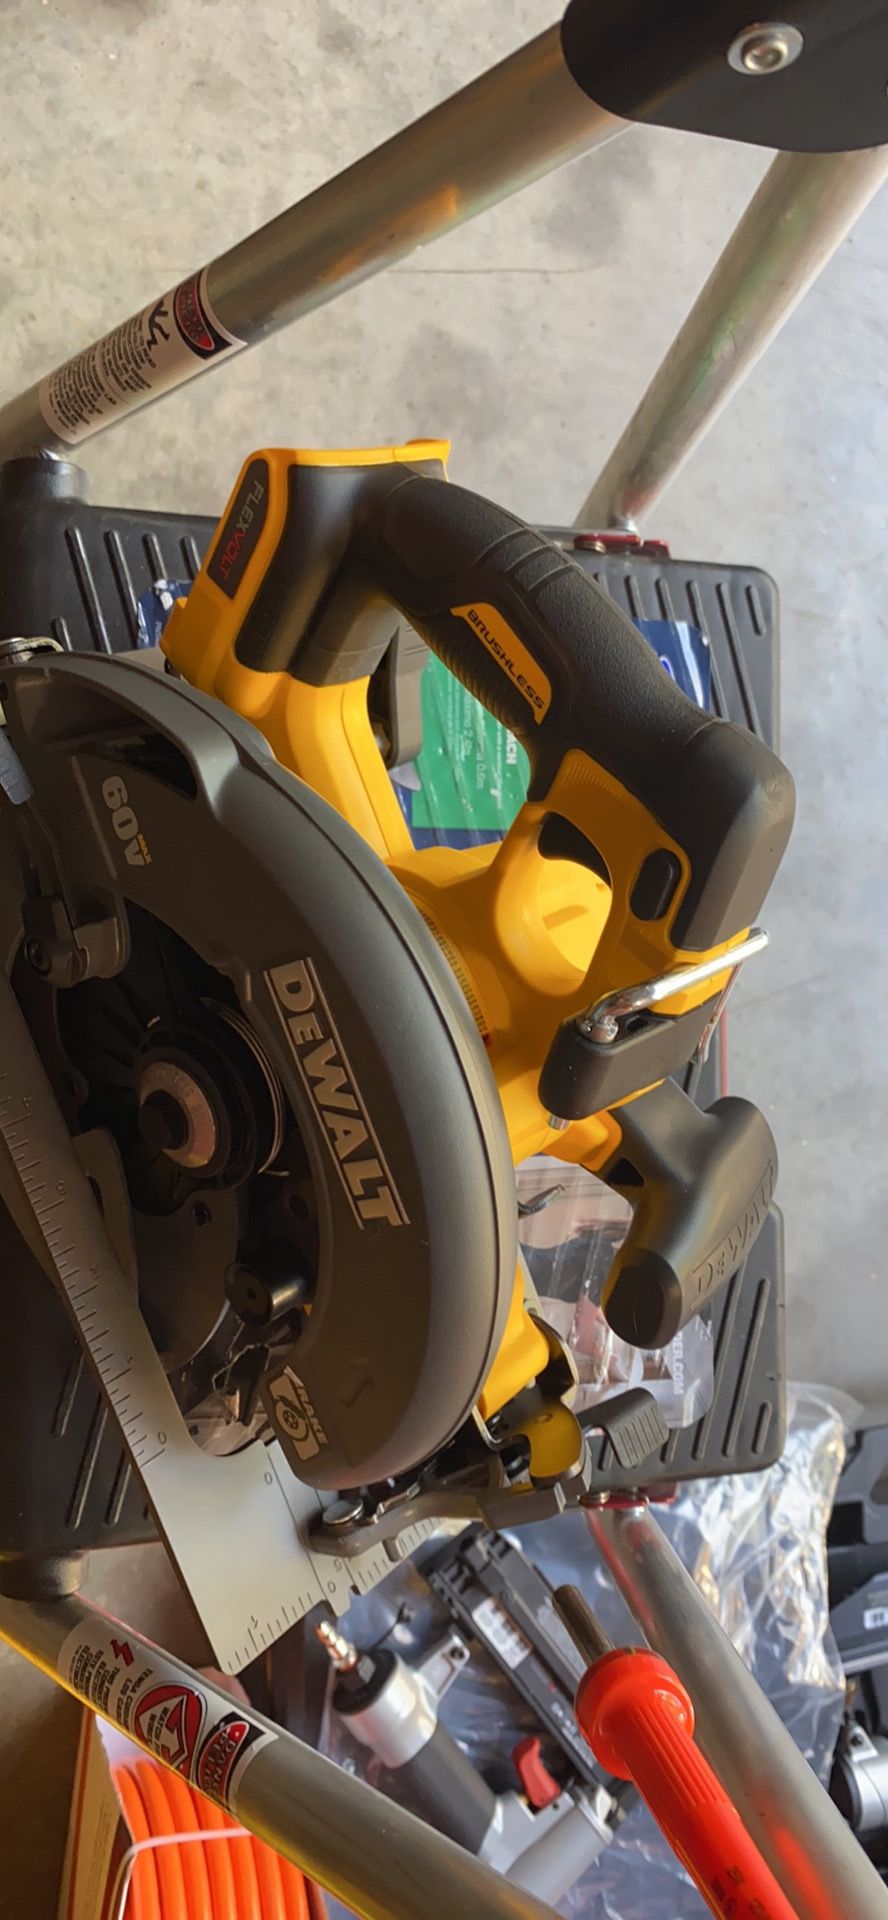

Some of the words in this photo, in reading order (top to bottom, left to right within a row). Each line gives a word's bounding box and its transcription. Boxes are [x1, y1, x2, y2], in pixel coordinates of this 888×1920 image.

[221, 480, 265, 580] FLEXVOLT
[467, 609, 545, 710] BRUSHLESS
[102, 776, 146, 866] 60V
[267, 957, 408, 1229] DEWALT
[133, 1668, 154, 1694] TENGA
[158, 1706, 170, 1740] WATCH
